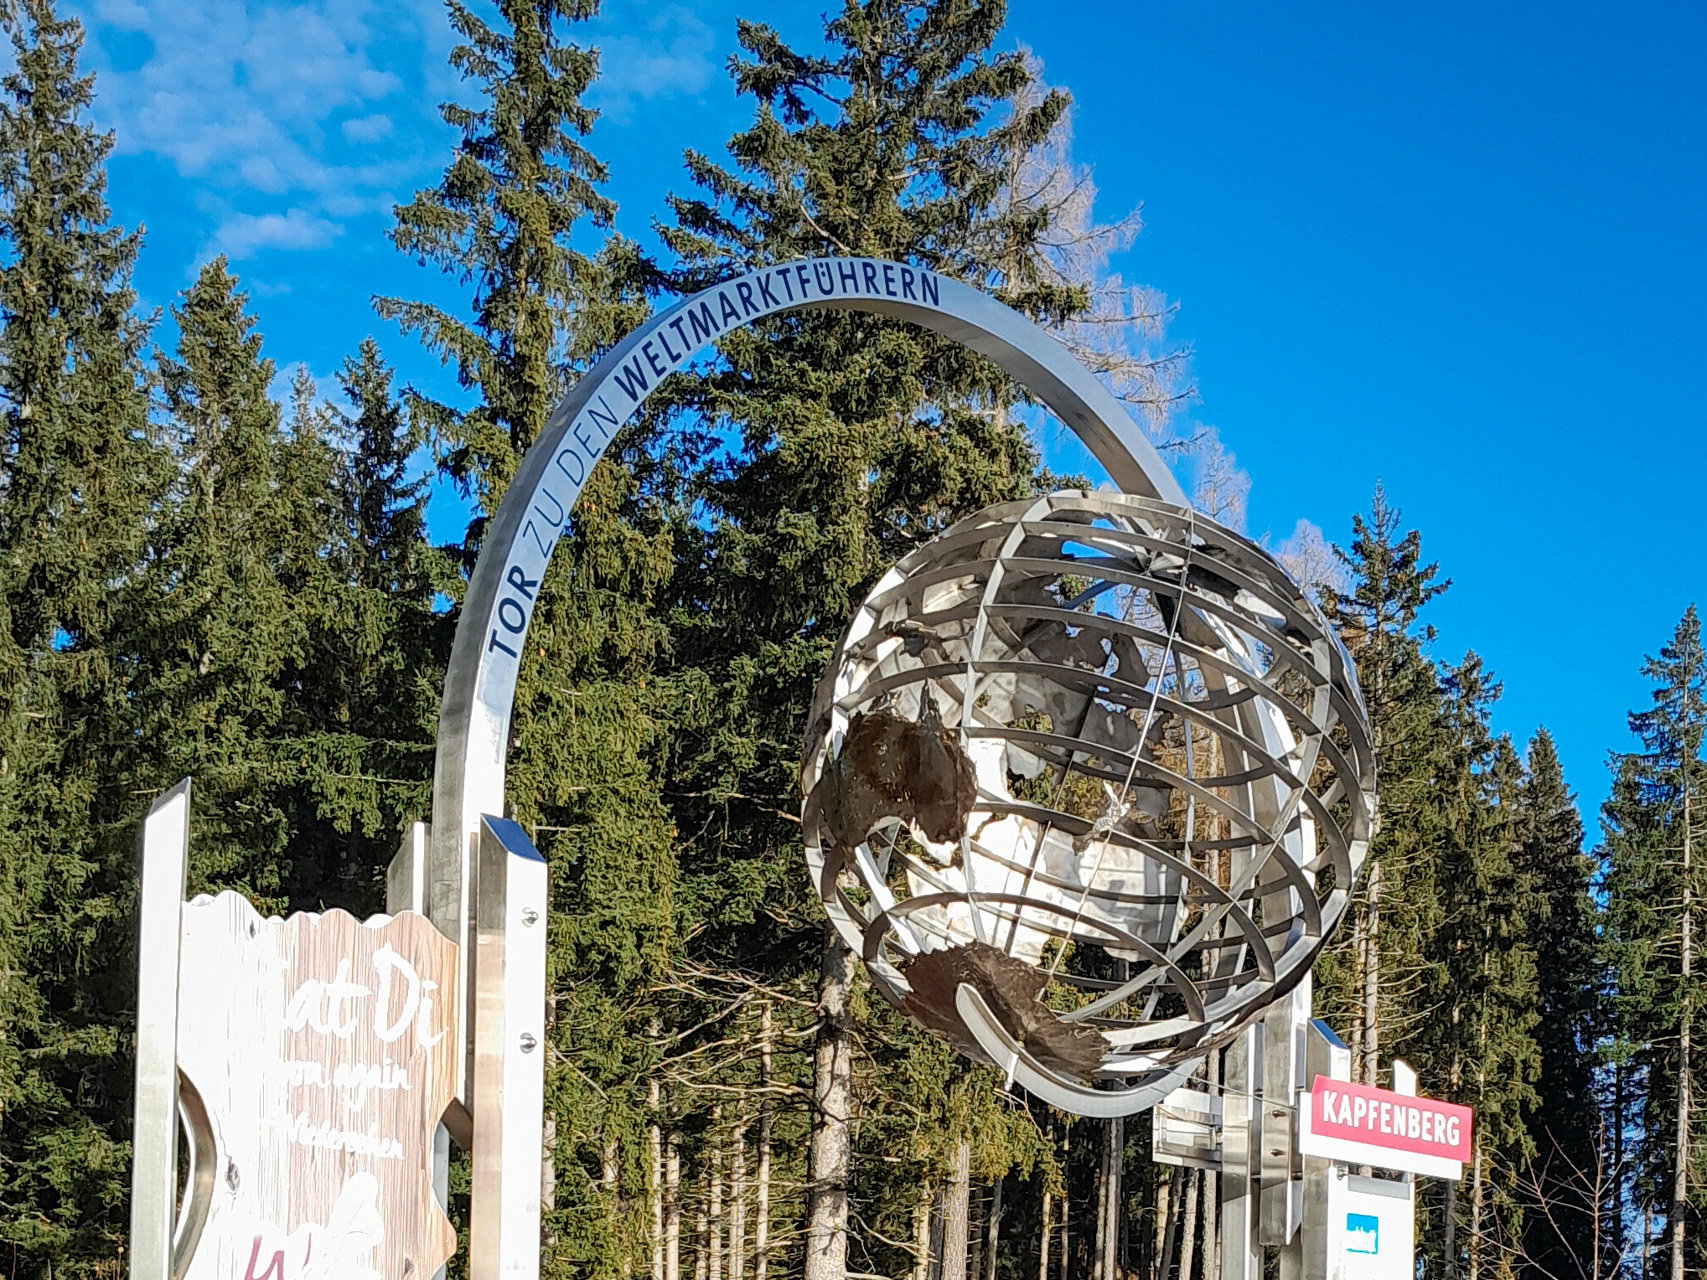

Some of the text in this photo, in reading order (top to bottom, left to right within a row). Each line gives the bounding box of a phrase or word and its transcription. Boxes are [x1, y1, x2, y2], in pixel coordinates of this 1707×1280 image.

[489, 261, 940, 659] TOR ZU DEN WELTMARKTFÜHRERN
[1323, 1090, 1460, 1146] KAPFENBERG
